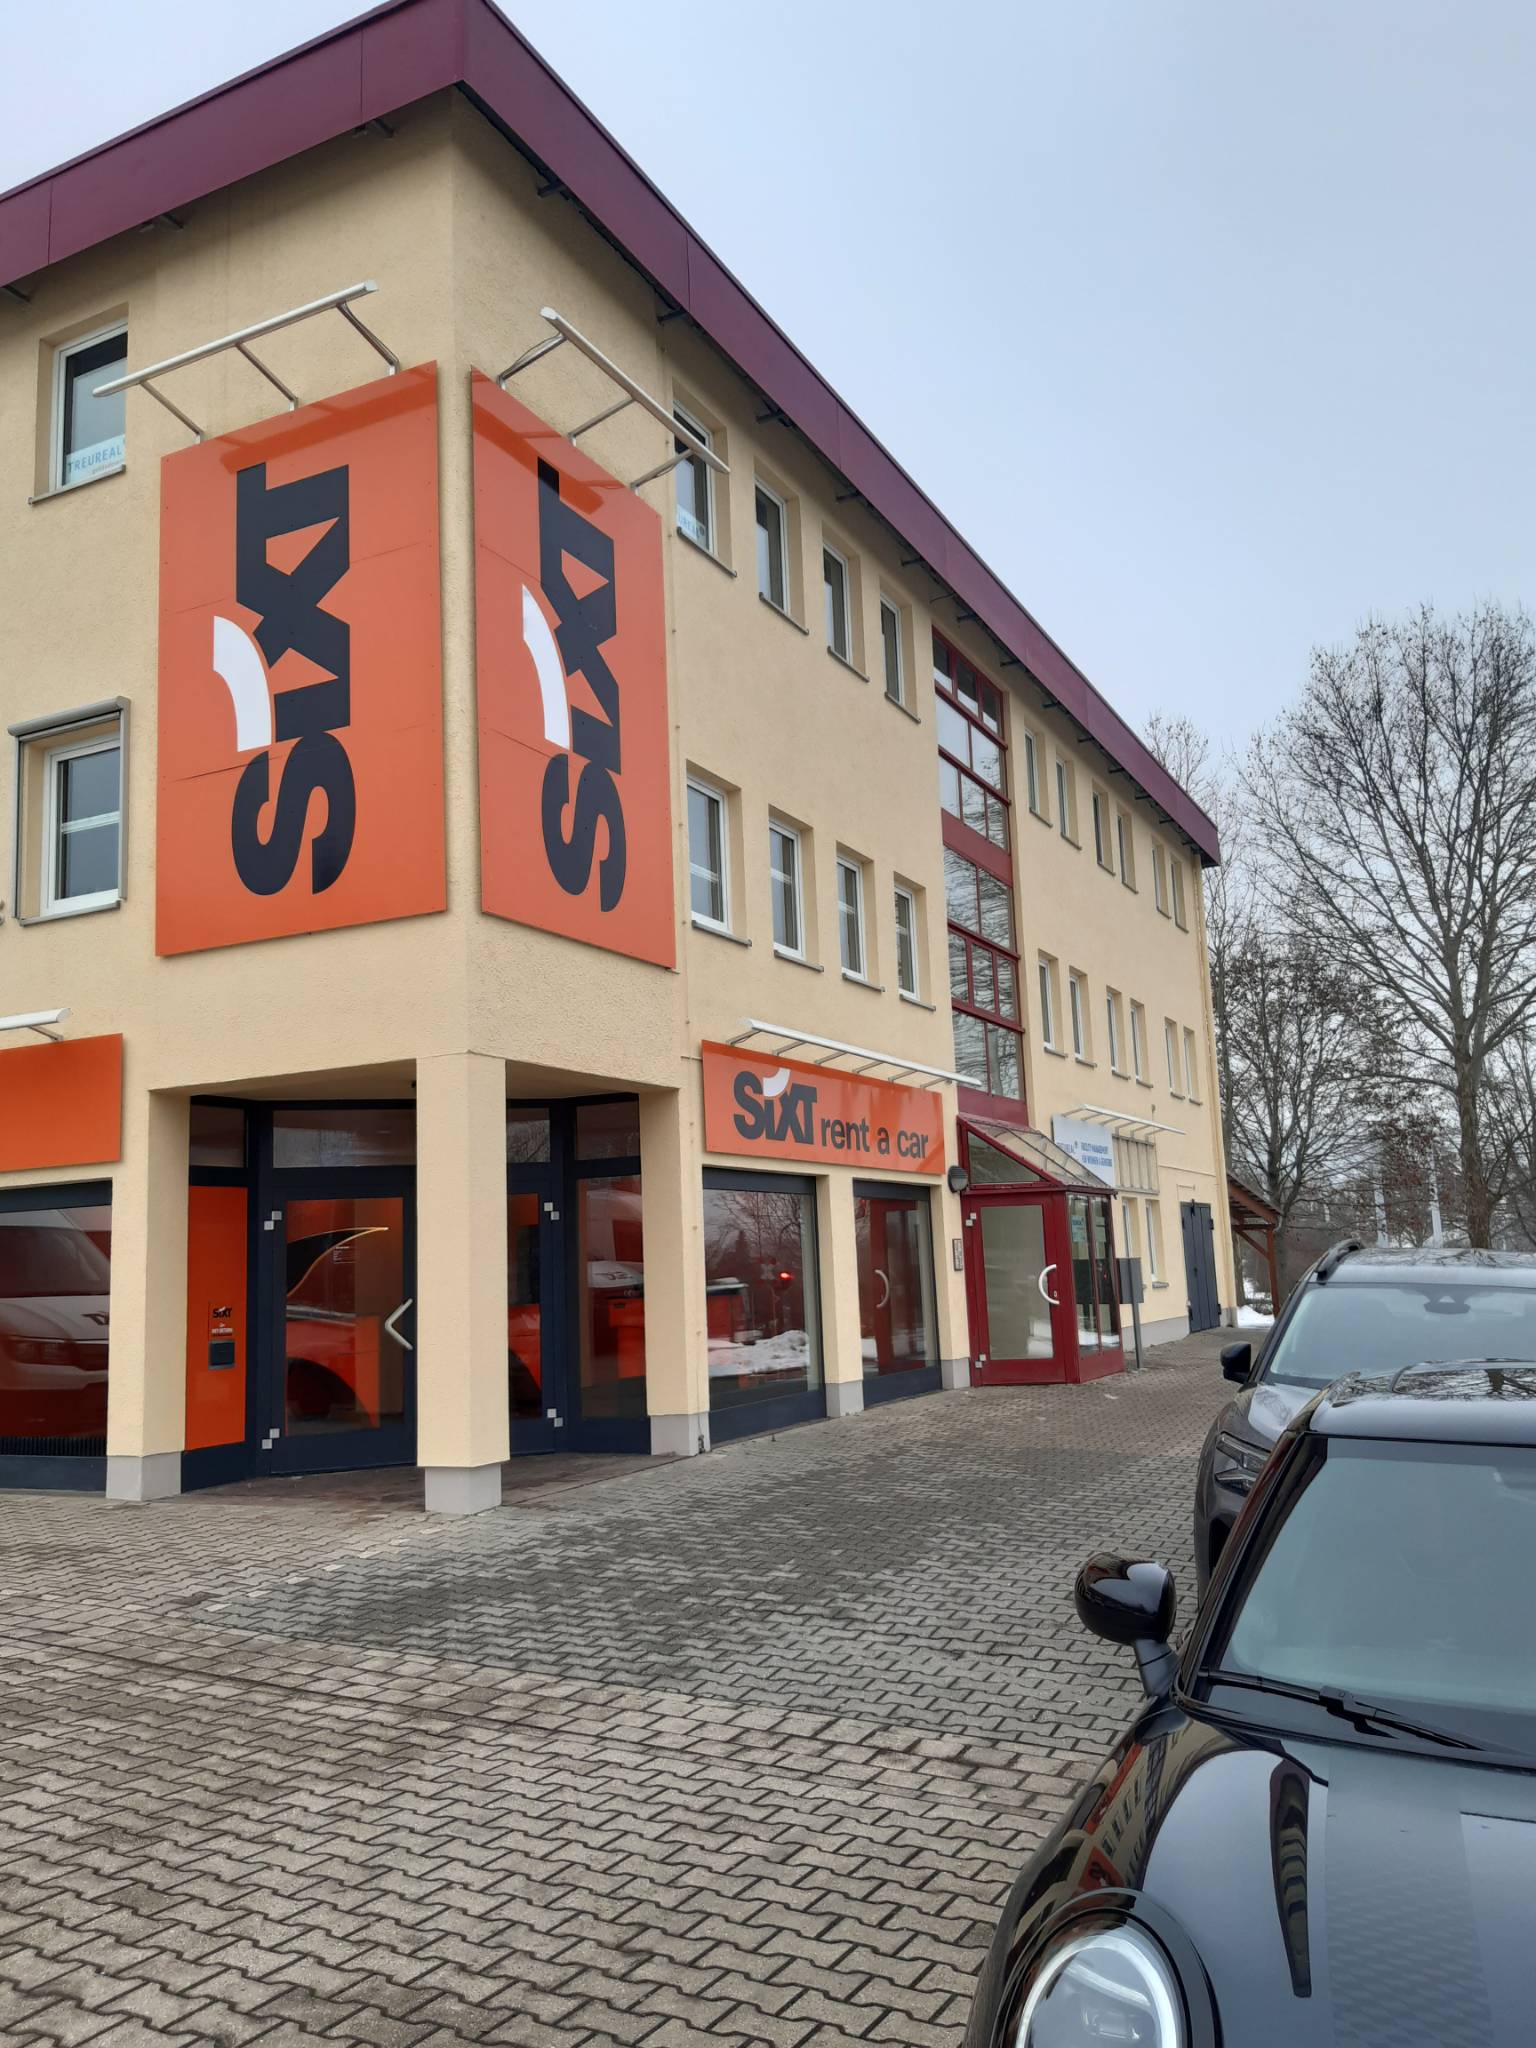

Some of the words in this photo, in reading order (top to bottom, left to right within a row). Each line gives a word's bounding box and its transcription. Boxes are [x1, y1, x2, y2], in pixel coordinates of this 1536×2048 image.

[67, 445, 123, 473] TREUREAL
[213, 462, 357, 897] SIXT
[522, 456, 627, 913] SIXT
[733, 1067, 818, 1145] SIXT
[821, 1117, 870, 1152] rent
[876, 1127, 890, 1155] a
[897, 1130, 929, 1159] car
